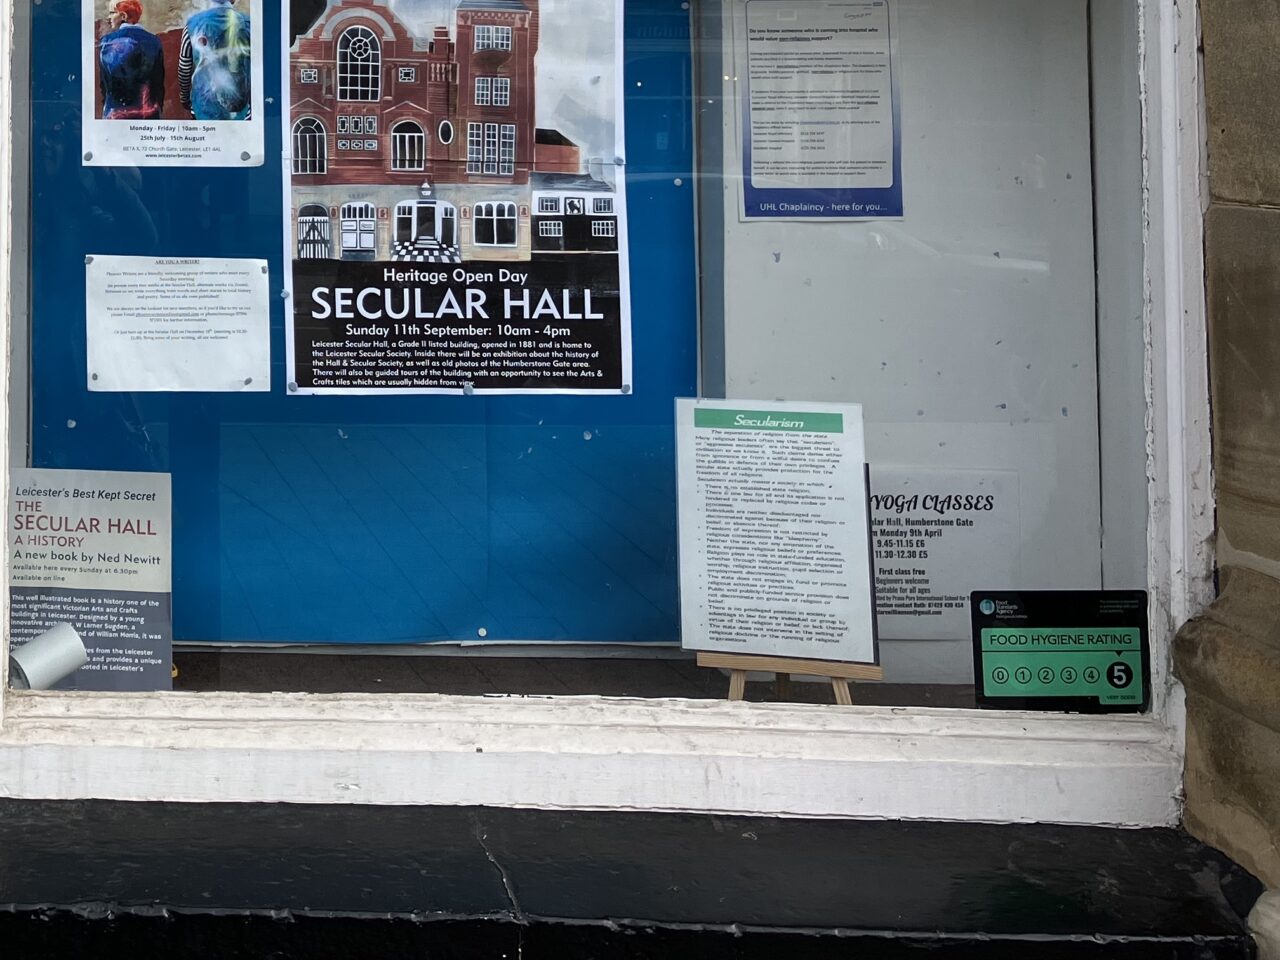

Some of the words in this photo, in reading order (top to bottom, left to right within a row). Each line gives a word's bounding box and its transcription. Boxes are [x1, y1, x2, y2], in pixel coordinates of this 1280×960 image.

[759, 203, 777, 211] UHL
[780, 203, 824, 213] Chaplaincy
[832, 203, 850, 211] here
[852, 203, 864, 211] for
[384, 269, 448, 285] Heritage
[453, 269, 494, 285] Open
[499, 269, 528, 286] Day
[311, 287, 489, 319] SECULAR
[504, 289, 603, 320] HALL
[346, 324, 389, 337] Sunday
[395, 324, 420, 335] 11th
[423, 324, 492, 338] September:
[498, 325, 529, 336] 10am
[543, 325, 570, 338] 4pm
[734, 414, 804, 429] Secularism
[16, 486, 69, 499] Leicester's
[72, 489, 96, 499] Best
[98, 490, 121, 501] Kept
[123, 490, 156, 501] Secret
[16, 501, 42, 512] THE
[872, 494, 919, 514] YOGA
[922, 495, 994, 514] CLASSES
[14, 515, 100, 533] SECULAR
[108, 518, 157, 535] HALL
[905, 518, 953, 526] Humberstone
[956, 518, 973, 526] Gate
[14, 534, 23, 545] A
[27, 535, 84, 548] HISTORY
[880, 529, 907, 538] Monday
[910, 529, 922, 537] 9th
[924, 529, 942, 539] April
[14, 550, 22, 560] A
[51, 550, 77, 562] book
[81, 551, 93, 564] by
[98, 552, 120, 563] Ned
[124, 554, 160, 565] Newitt
[990, 635, 1028, 645] FOOD
[1032, 635, 1084, 645] HYGIENE
[1087, 635, 1132, 645] RATING
[997, 671, 1004, 680] 0
[1042, 671, 1050, 680] 2
[1066, 671, 1072, 680] 3
[1087, 671, 1095, 679] 4
[1113, 665, 1126, 685] 5
